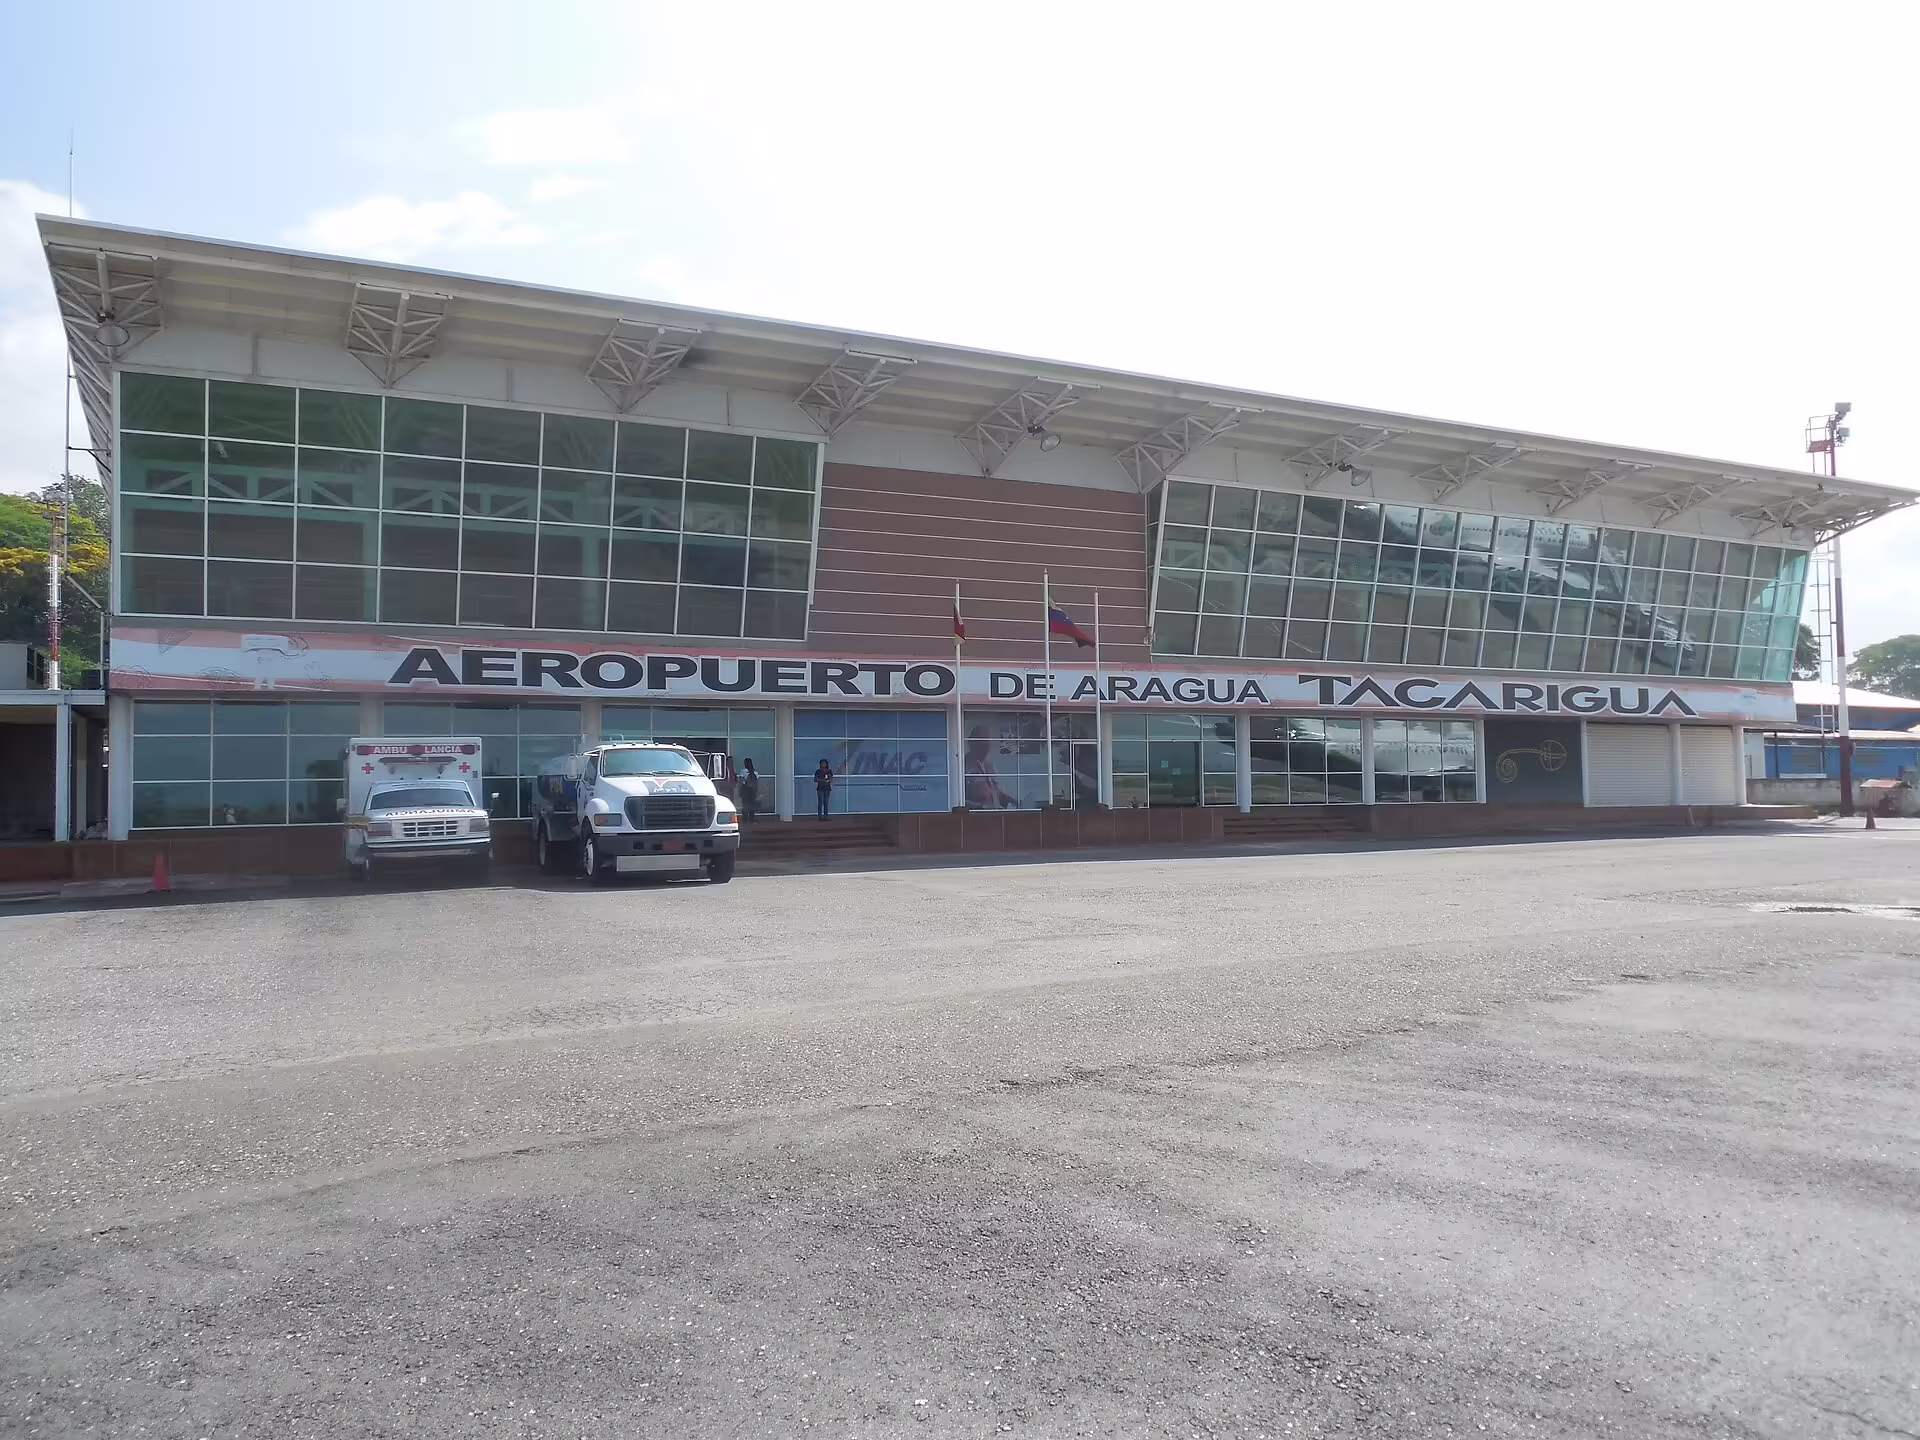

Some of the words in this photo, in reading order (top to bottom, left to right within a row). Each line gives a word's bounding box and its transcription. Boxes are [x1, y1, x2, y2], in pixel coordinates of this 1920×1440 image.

[387, 647, 956, 696] AEROPUERTO
[989, 672, 1056, 700] DE
[1070, 675, 1270, 704] ARAGUA
[1297, 674, 1698, 716] TACARIGUA
[373, 745, 408, 754] AMBU
[424, 745, 462, 753] LANCIA
[851, 751, 928, 775] INAC
